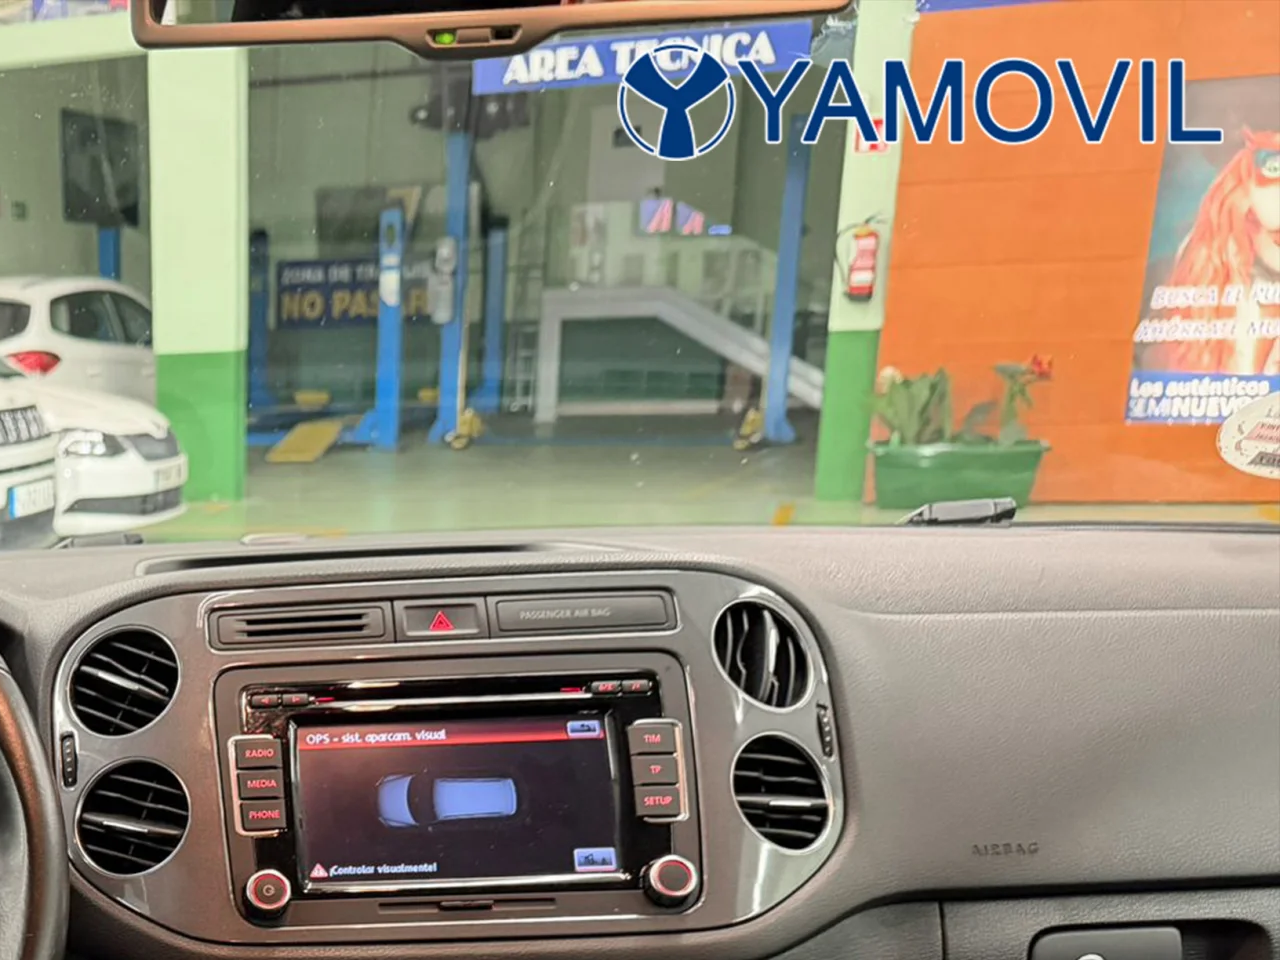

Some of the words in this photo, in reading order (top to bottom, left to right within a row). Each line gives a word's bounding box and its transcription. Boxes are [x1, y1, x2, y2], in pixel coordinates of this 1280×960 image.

[503, 44, 604, 85] AREA
[281, 290, 325, 321] NO
[1130, 378, 1164, 398] Los
[520, 608, 571, 620] PASSENGER
[305, 732, 330, 745] OPS
[415, 728, 447, 742] visual
[643, 734, 661, 744] TIM
[245, 748, 274, 759] RADIO
[247, 779, 277, 789] MEDIA
[644, 796, 673, 806] SETUP
[249, 809, 280, 820] PHONE
[972, 842, 1039, 857] AIRBAG
